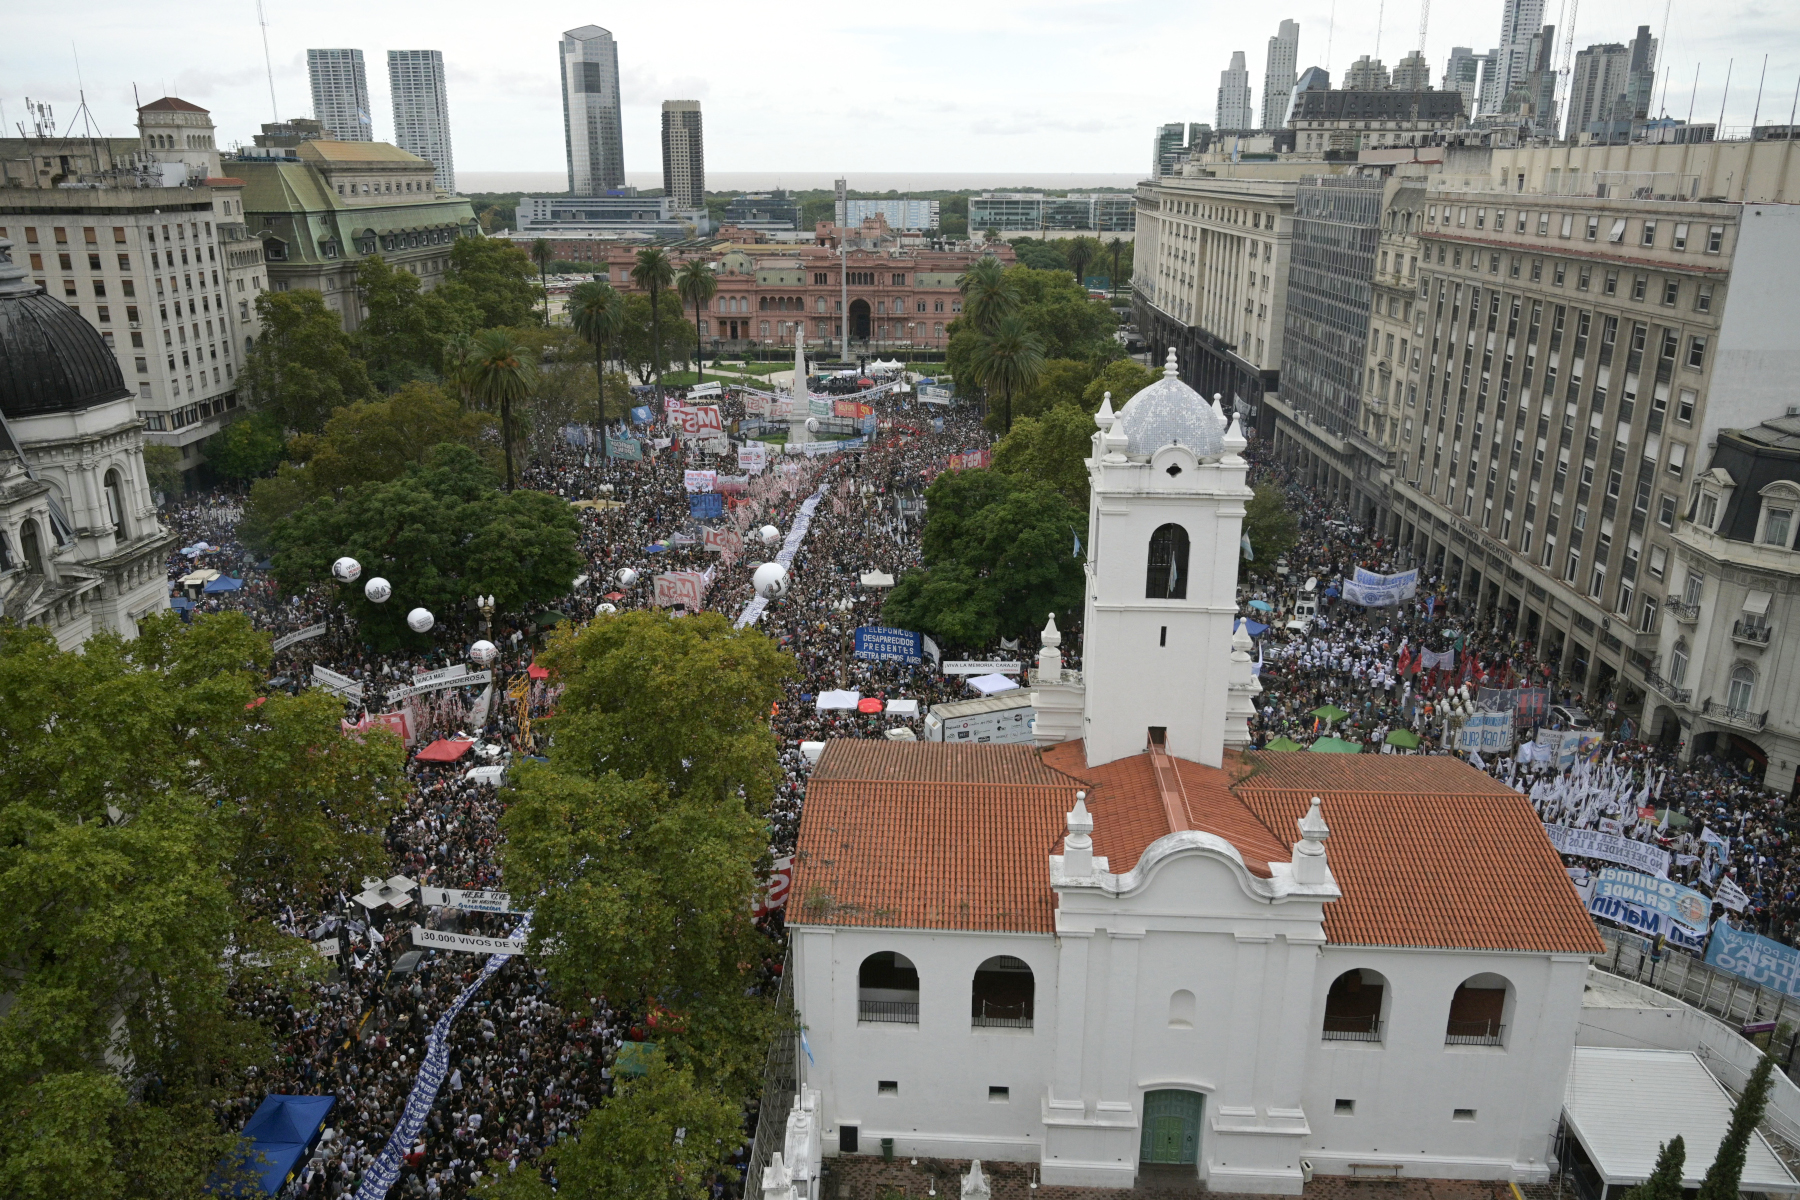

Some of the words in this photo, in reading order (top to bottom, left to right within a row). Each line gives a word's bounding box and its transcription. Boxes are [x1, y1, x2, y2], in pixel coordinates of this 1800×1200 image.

[1451, 516, 1457, 527] LA
[1459, 522, 1479, 540] FRANCO
[1481, 537, 1513, 565] ARGENTINA
[863, 634, 914, 646] DESAPARECIDOS
[863, 643, 914, 655] PRESENTES
[855, 651, 880, 660] FOETRA
[880, 652, 904, 663] BUENOS
[403, 682, 443, 695] GARGANTA
[444, 674, 485, 685] PODEROSA
[461, 891, 485, 899] HEBE
[490, 892, 508, 900] VIVE
[420, 931, 456, 943] ¡30.000
[457, 936, 492, 947] VIVOS
[494, 940, 510, 948] DE
